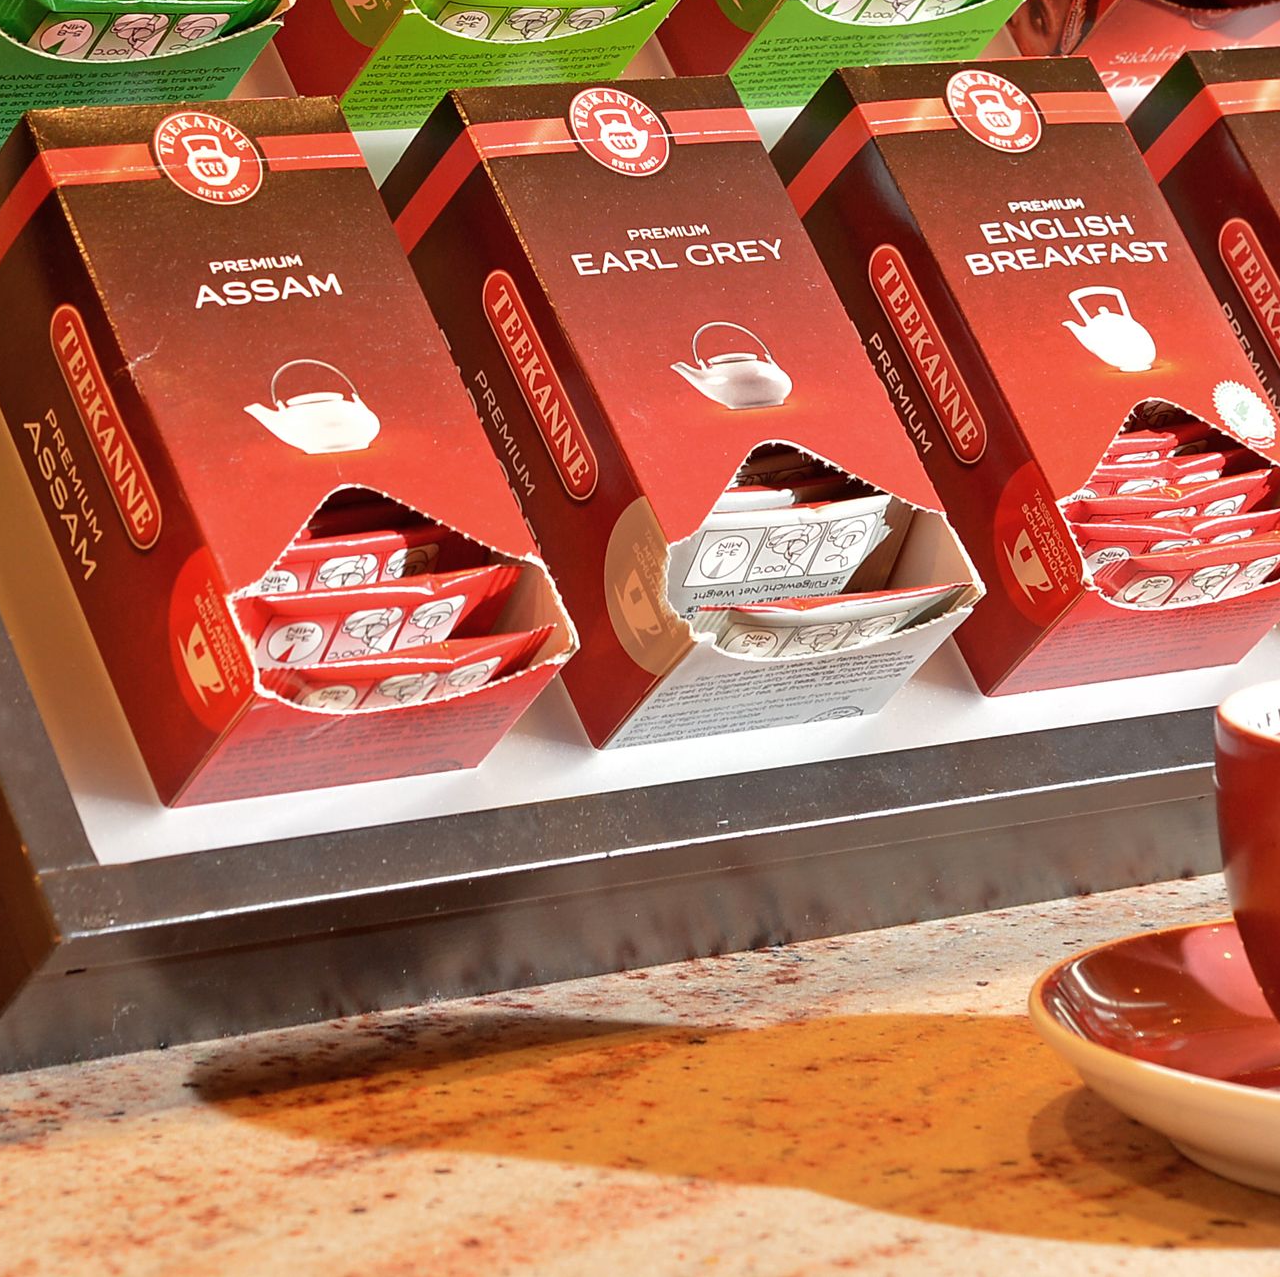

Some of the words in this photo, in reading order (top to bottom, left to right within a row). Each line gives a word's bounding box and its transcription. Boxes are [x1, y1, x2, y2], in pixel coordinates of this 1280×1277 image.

[47, 72, 86, 82] quality
[953, 73, 1029, 109] TEEKANNE
[574, 91, 657, 129] TEEKANNE
[159, 116, 247, 156] TEEKANNE
[611, 158, 636, 171] SEIT
[197, 186, 224, 200] SEIT
[229, 184, 252, 199] 1882
[1007, 197, 1085, 214] PREMIUM
[626, 223, 711, 242] PREMIUM
[979, 214, 1135, 245] ENGLISH
[209, 254, 304, 275] PREMIUM
[570, 251, 678, 277] EARL
[685, 238, 783, 267] GREY
[964, 241, 1169, 276] BREAKFAST
[195, 272, 344, 310] ASSAM
[877, 258, 978, 453] TEEKANNE
[490, 284, 590, 486] TEEKANNE
[869, 332, 933, 455] PREMIUM
[59, 320, 153, 535] TEEKANNE
[474, 370, 535, 497] PREMIUM
[45, 408, 103, 543] PREMIUM
[23, 421, 97, 581] ASSAM
[1031, 505, 1048, 528] MIT
[716, 549, 740, 558] 3-5
[717, 541, 743, 550] MIN
[1021, 502, 1070, 595] SCHUTZHÜLLE
[1034, 489, 1081, 584] TASSENPORTION
[692, 589, 736, 602] Weight
